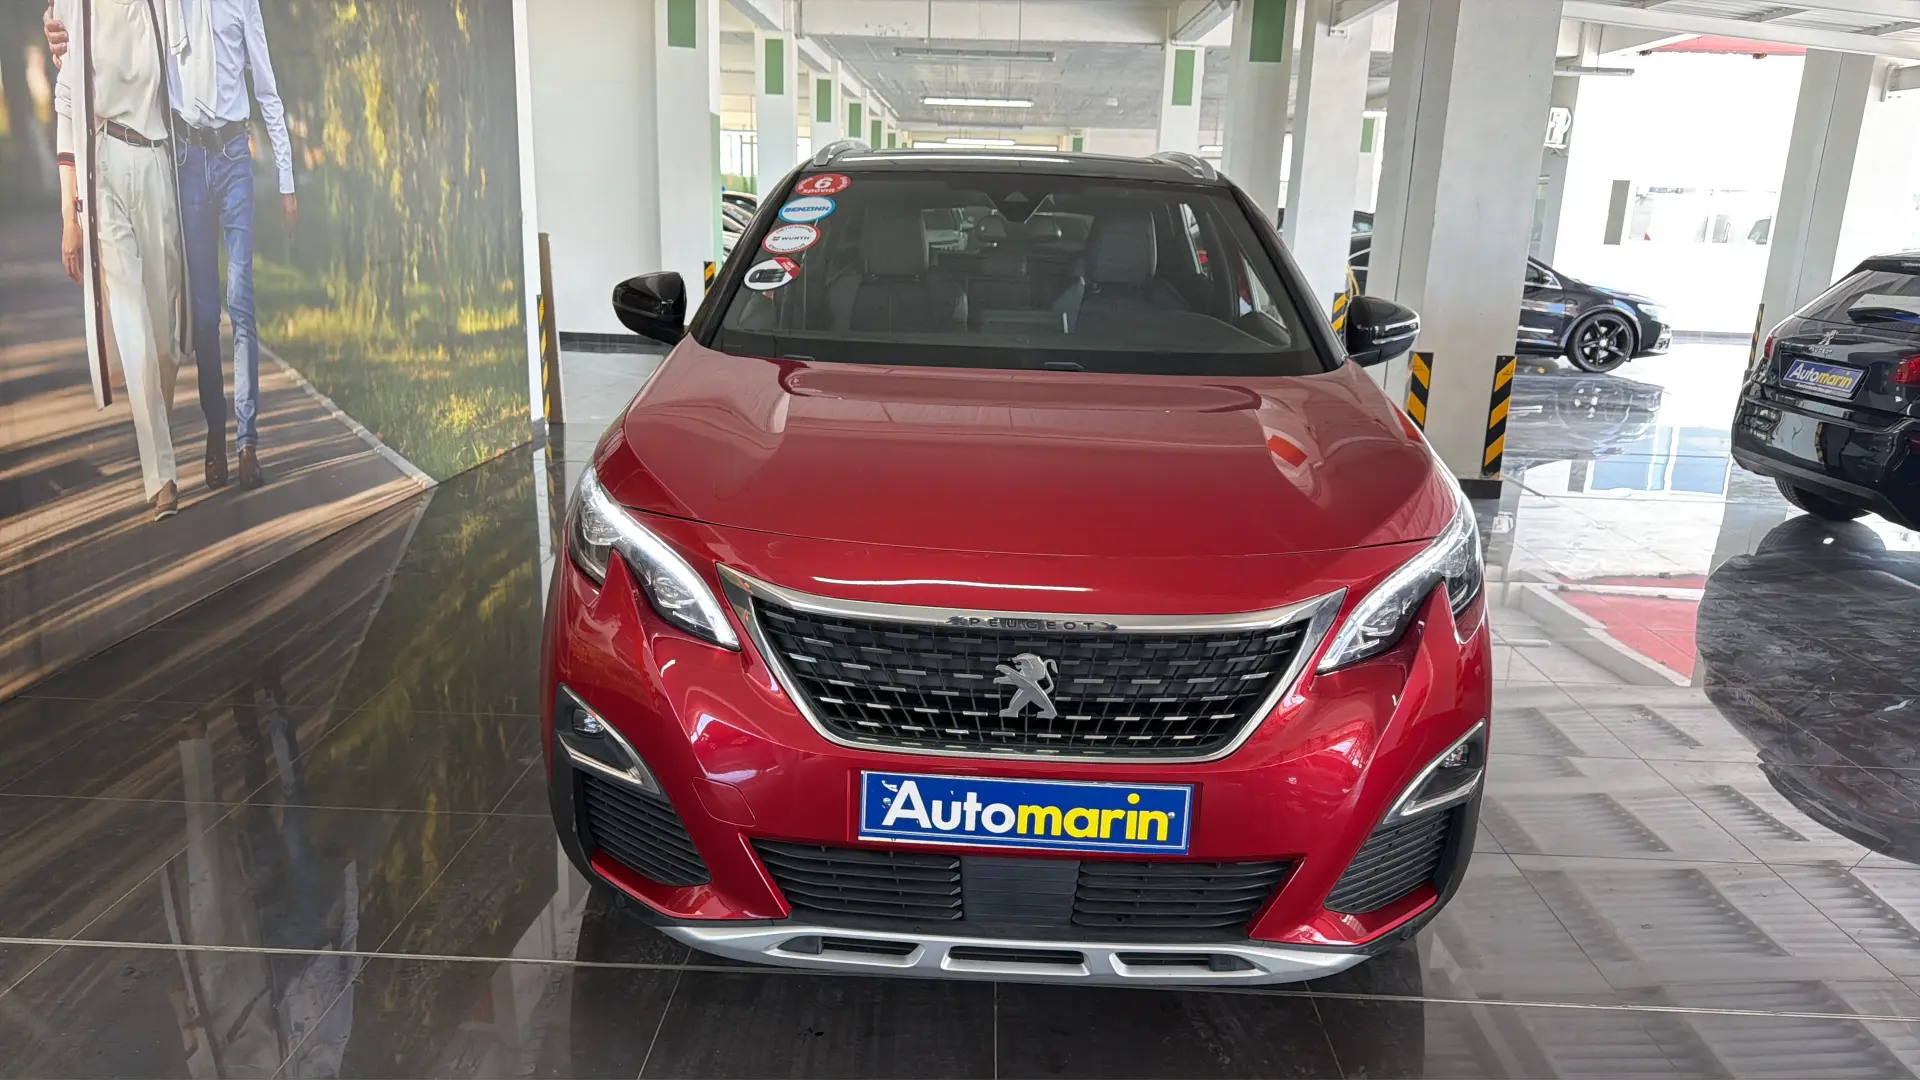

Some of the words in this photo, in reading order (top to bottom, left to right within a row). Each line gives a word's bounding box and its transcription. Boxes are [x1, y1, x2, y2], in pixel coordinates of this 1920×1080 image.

[814, 176, 833, 189] 6
[1789, 363, 1853, 388] Automarin
[969, 617, 1095, 630] PEUGEOT
[882, 780, 1168, 842] Automarin
